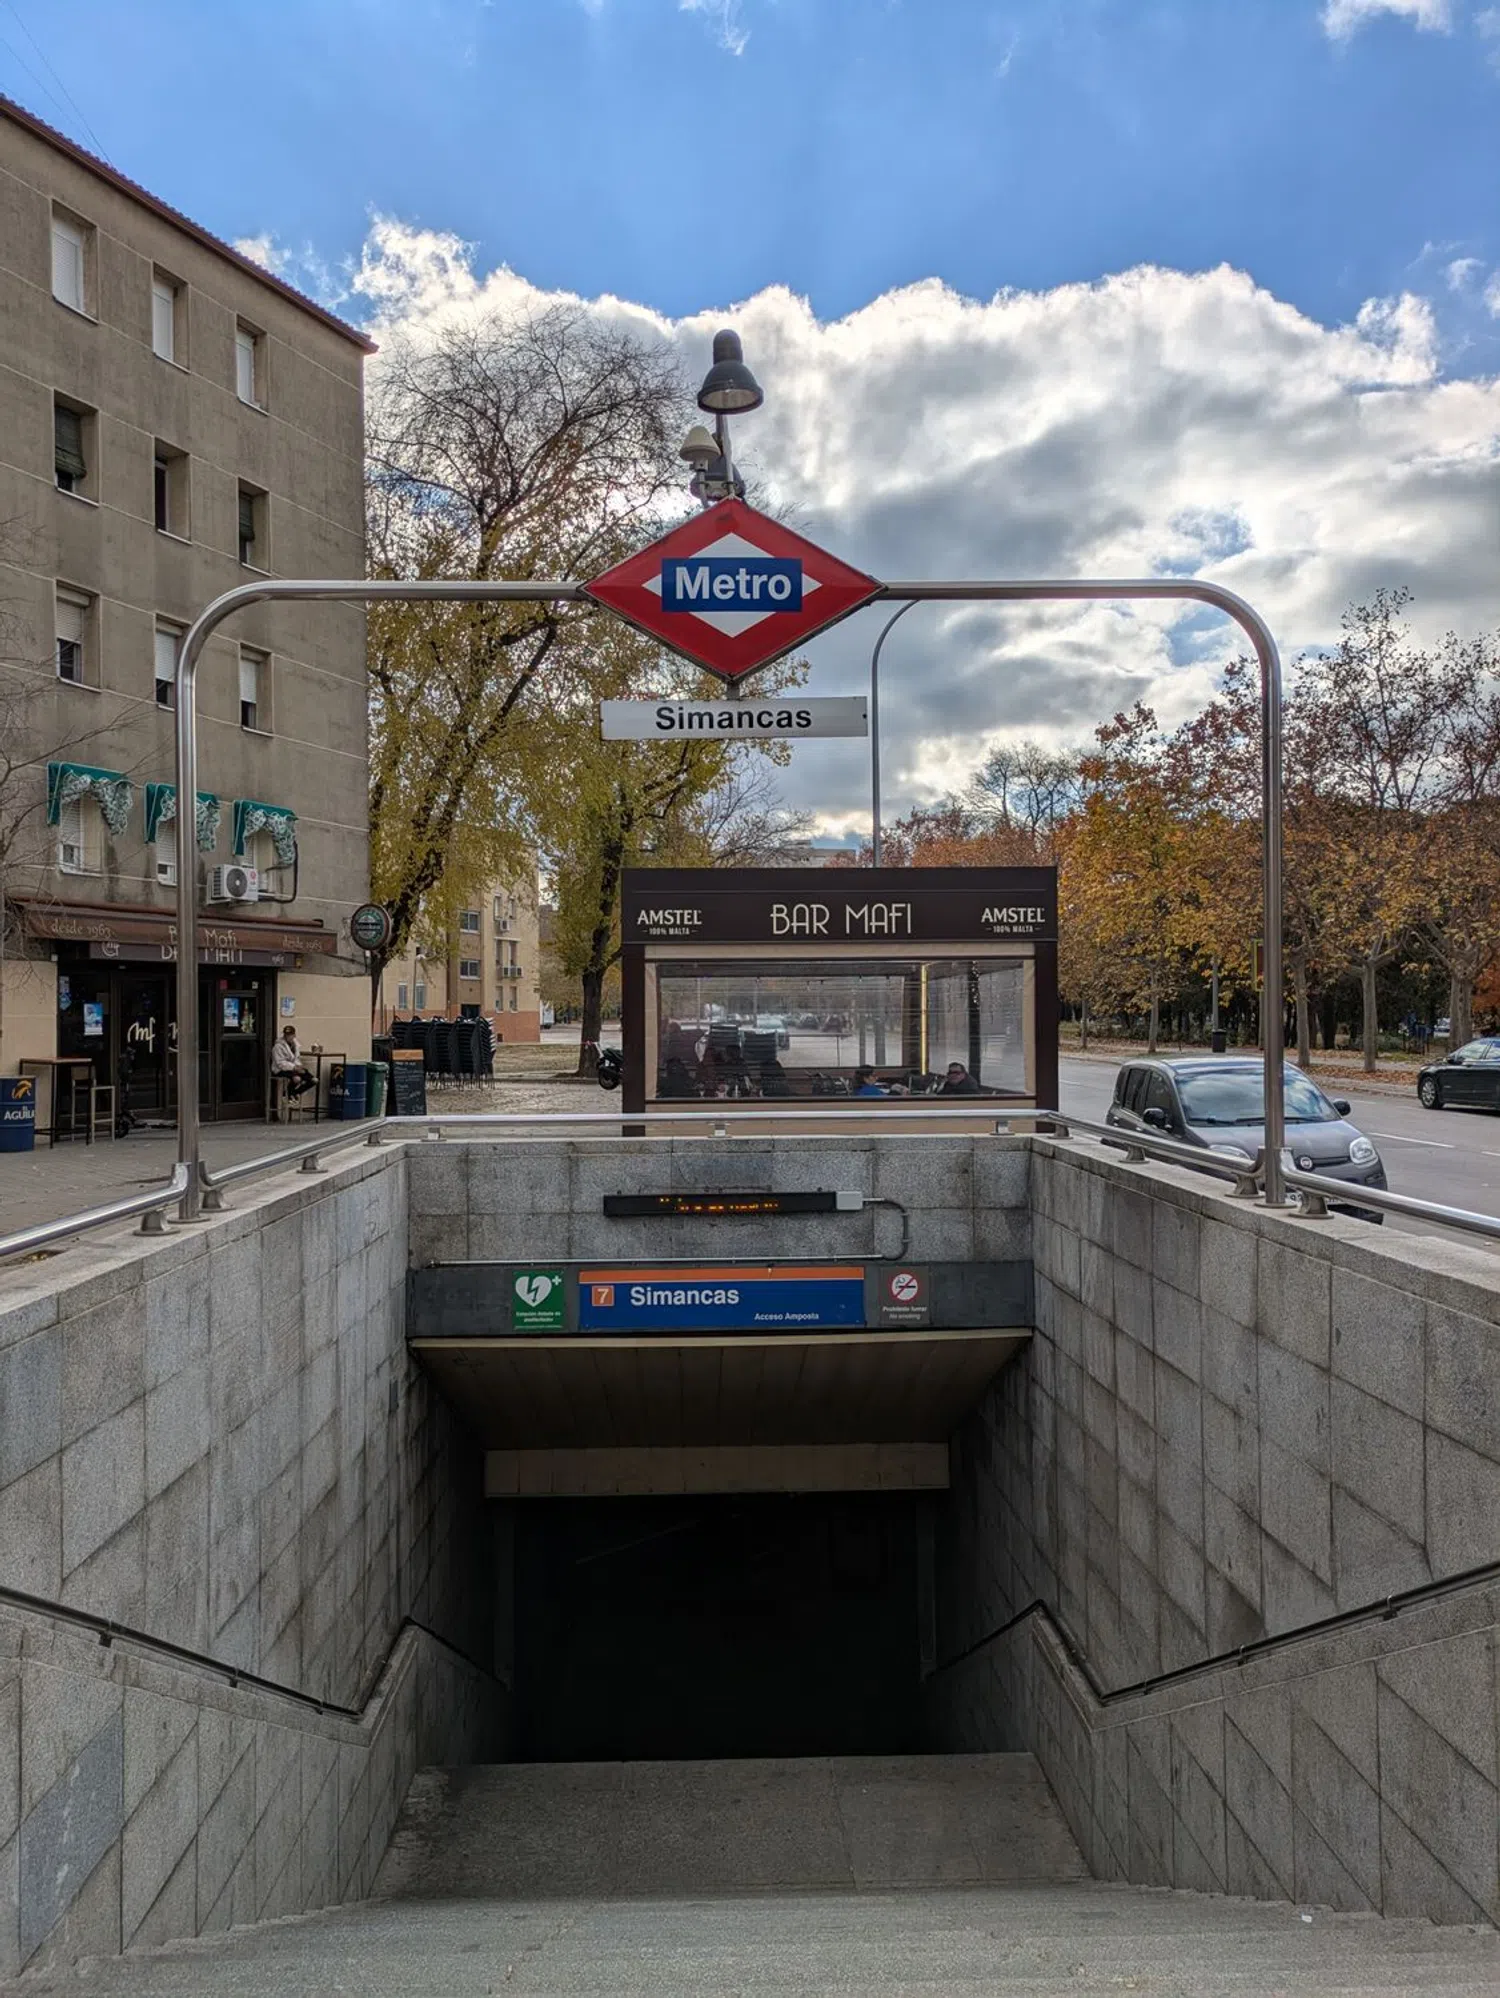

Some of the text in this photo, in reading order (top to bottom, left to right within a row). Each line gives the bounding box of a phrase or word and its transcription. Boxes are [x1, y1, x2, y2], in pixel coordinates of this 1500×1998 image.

[675, 566, 792, 601] Metro
[655, 706, 812, 731] Simancas
[637, 909, 703, 925] AMSTEL
[769, 903, 912, 935] BAR MAFI
[980, 907, 1046, 923] AMSTEL
[1012, 925, 1034, 933] MALTA
[597, 1288, 610, 1304] 7
[630, 1286, 740, 1306] Simancas
[754, 1313, 784, 1321] Acceso
